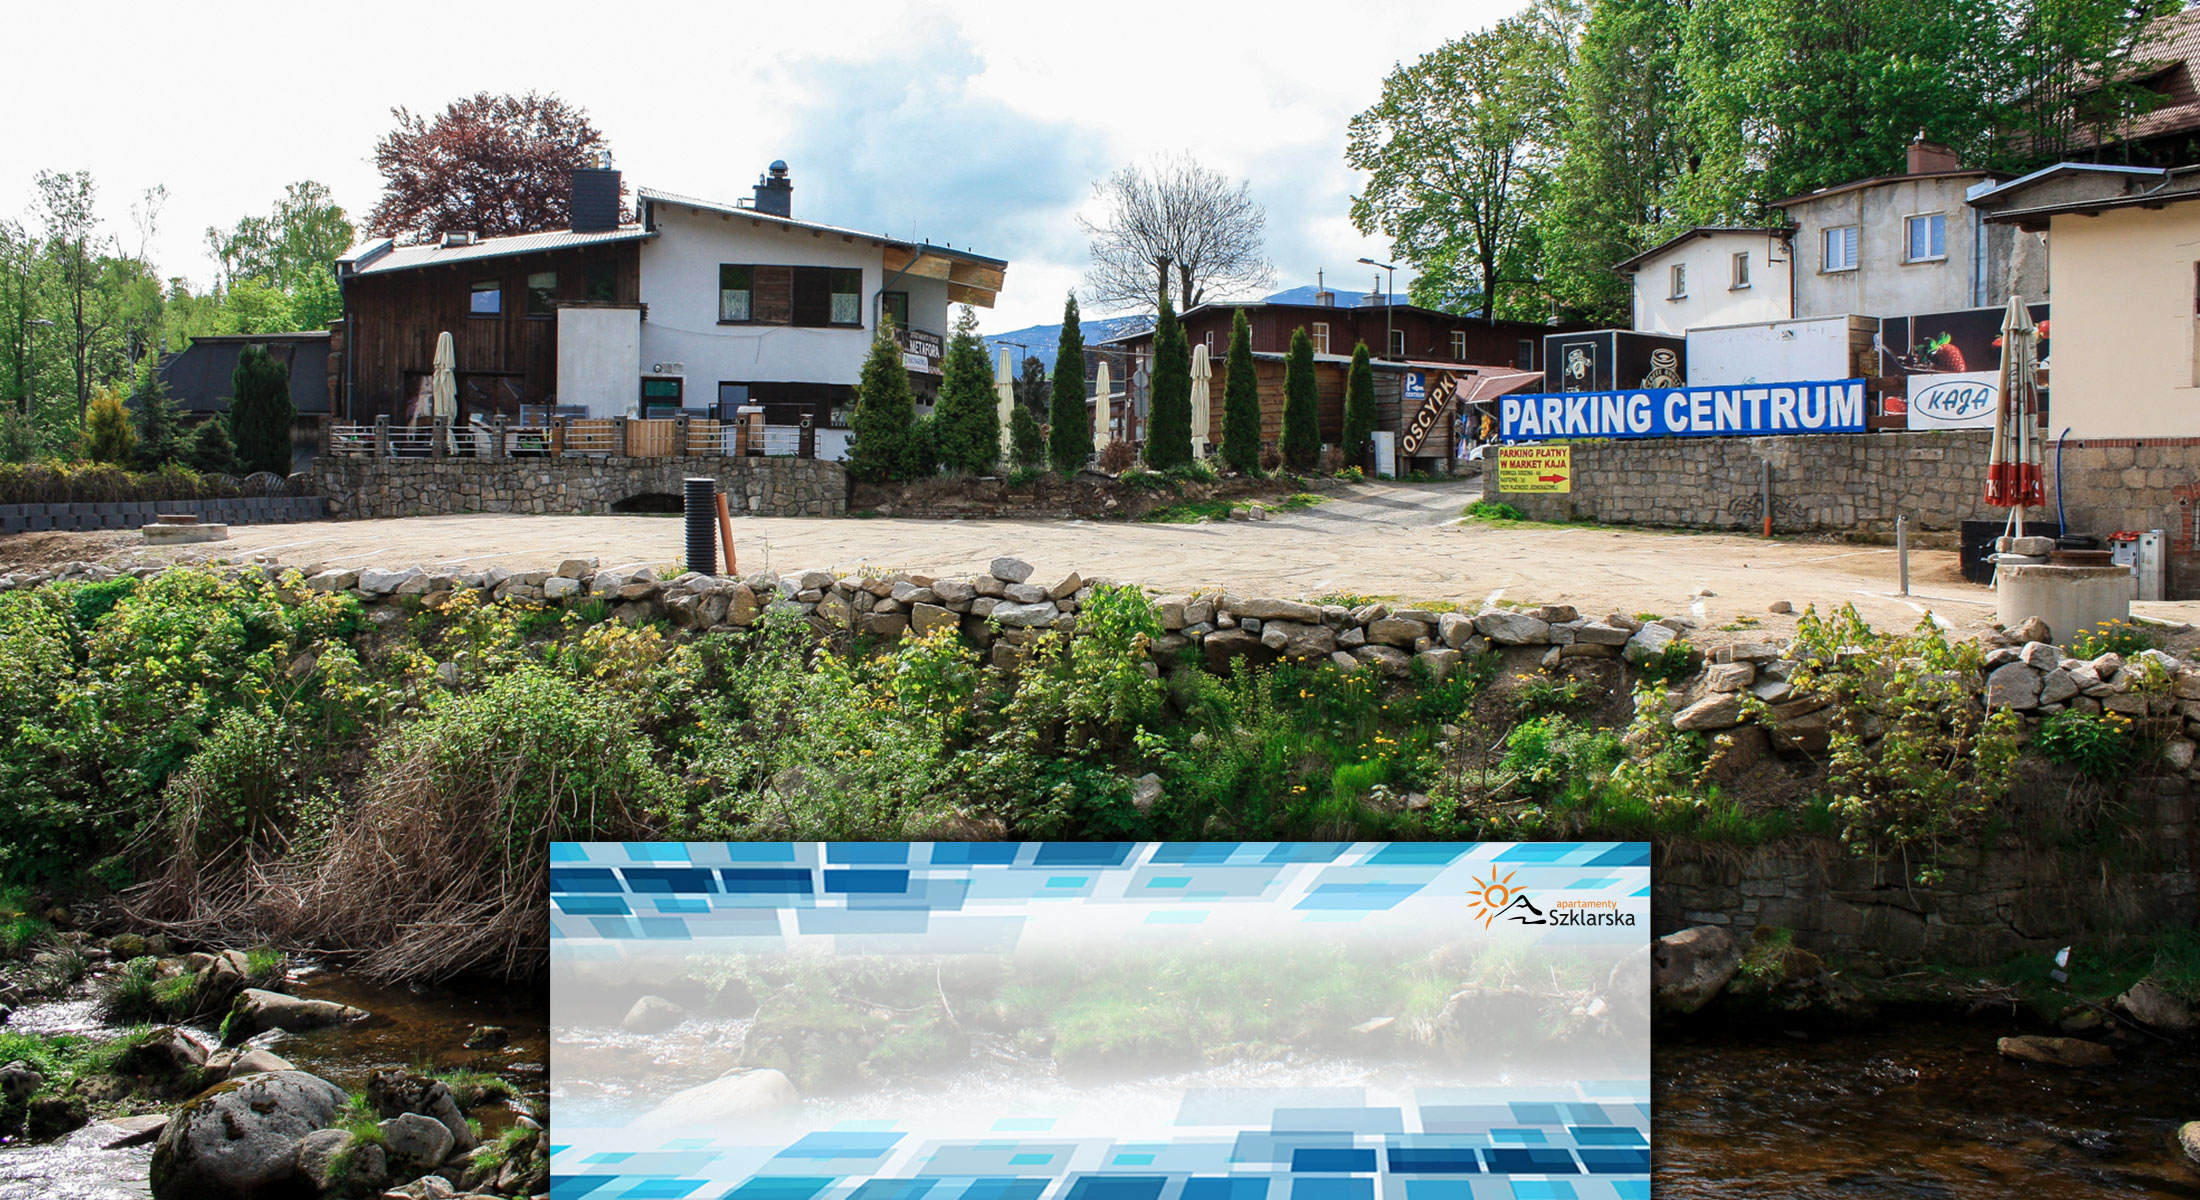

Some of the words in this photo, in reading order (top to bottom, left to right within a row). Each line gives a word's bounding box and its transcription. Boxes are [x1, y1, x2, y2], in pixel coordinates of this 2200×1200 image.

[910, 340, 940, 359] METAFORA
[1406, 372, 1417, 391] P
[1403, 370, 1457, 452] OSCYPKI
[1502, 394, 1651, 435] PARKING
[1664, 384, 1864, 433] CENTRUM
[1928, 388, 1989, 416] KAJA
[1499, 449, 1533, 457] PARKING
[1536, 448, 1567, 457] PŁATNY
[1500, 460, 1507, 468] W
[1510, 460, 1542, 468] MARKET
[1545, 460, 1566, 468] KAJA
